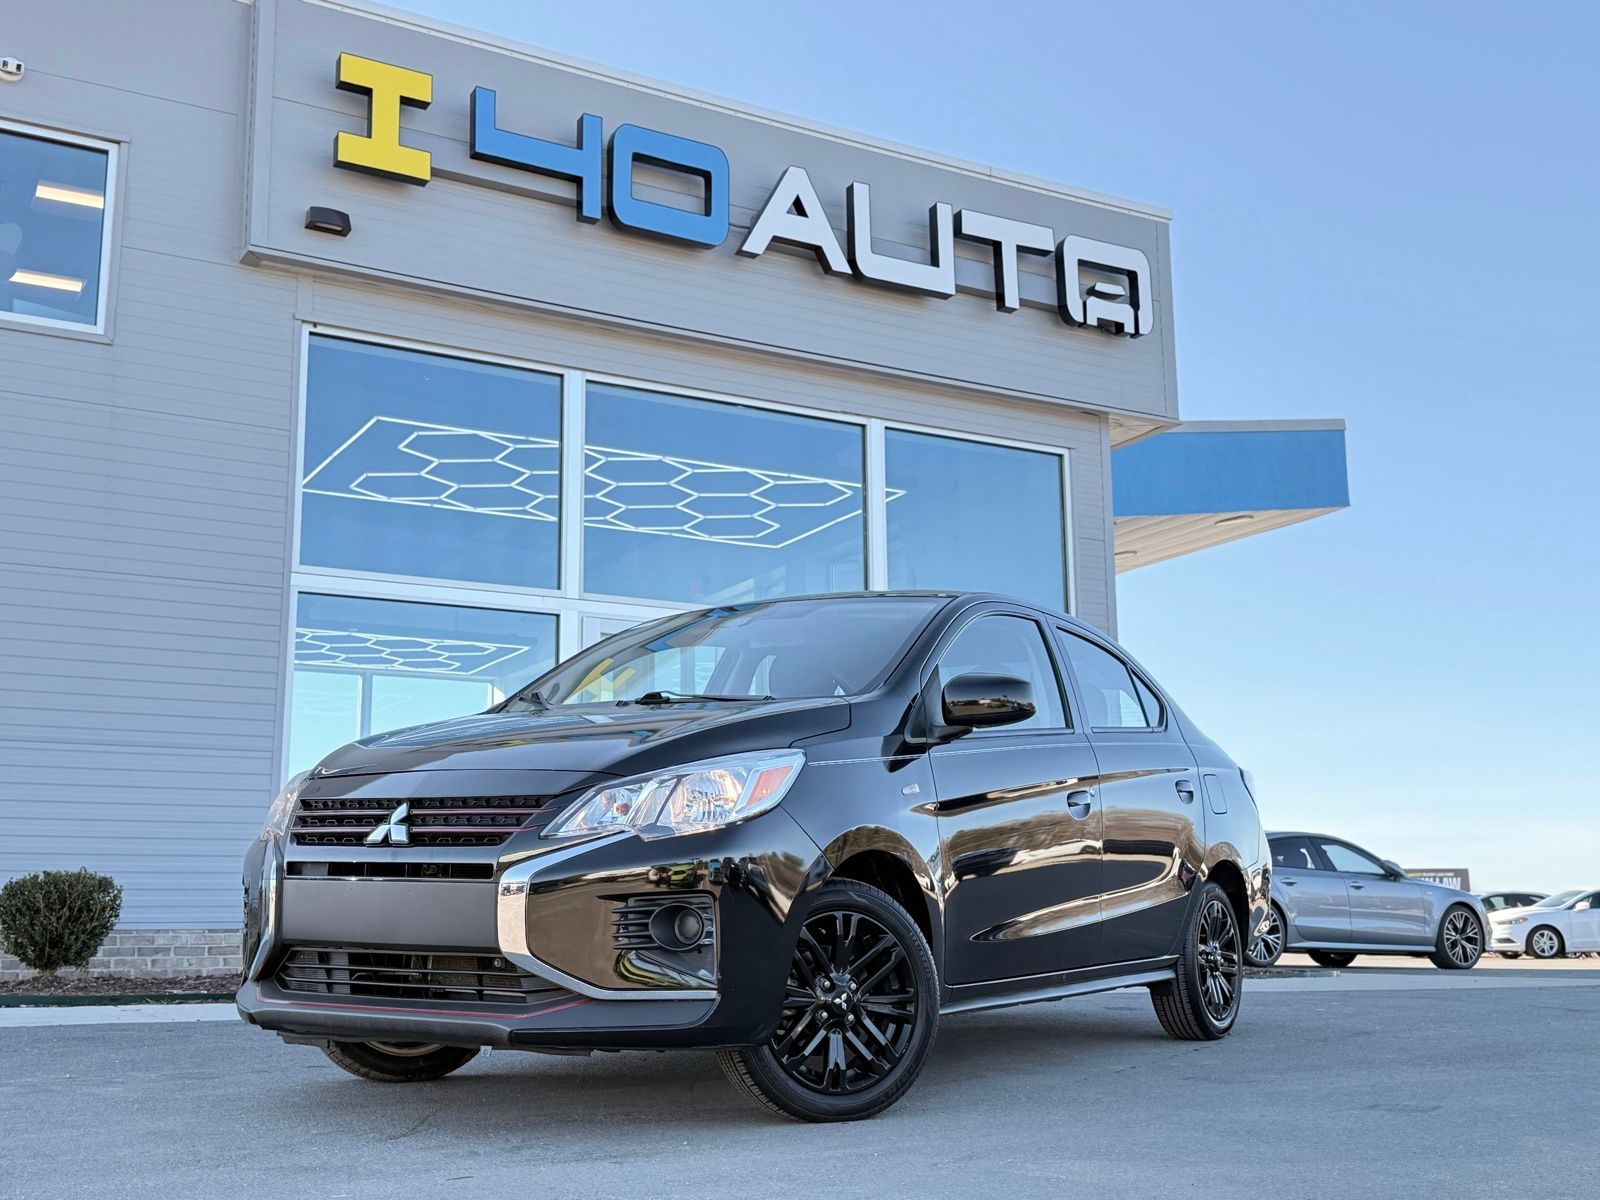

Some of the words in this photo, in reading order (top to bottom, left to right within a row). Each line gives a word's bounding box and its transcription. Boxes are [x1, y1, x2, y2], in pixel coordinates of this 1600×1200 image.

[334, 52, 433, 186] I
[470, 86, 730, 249] 40
[737, 165, 1153, 338] AUTO
